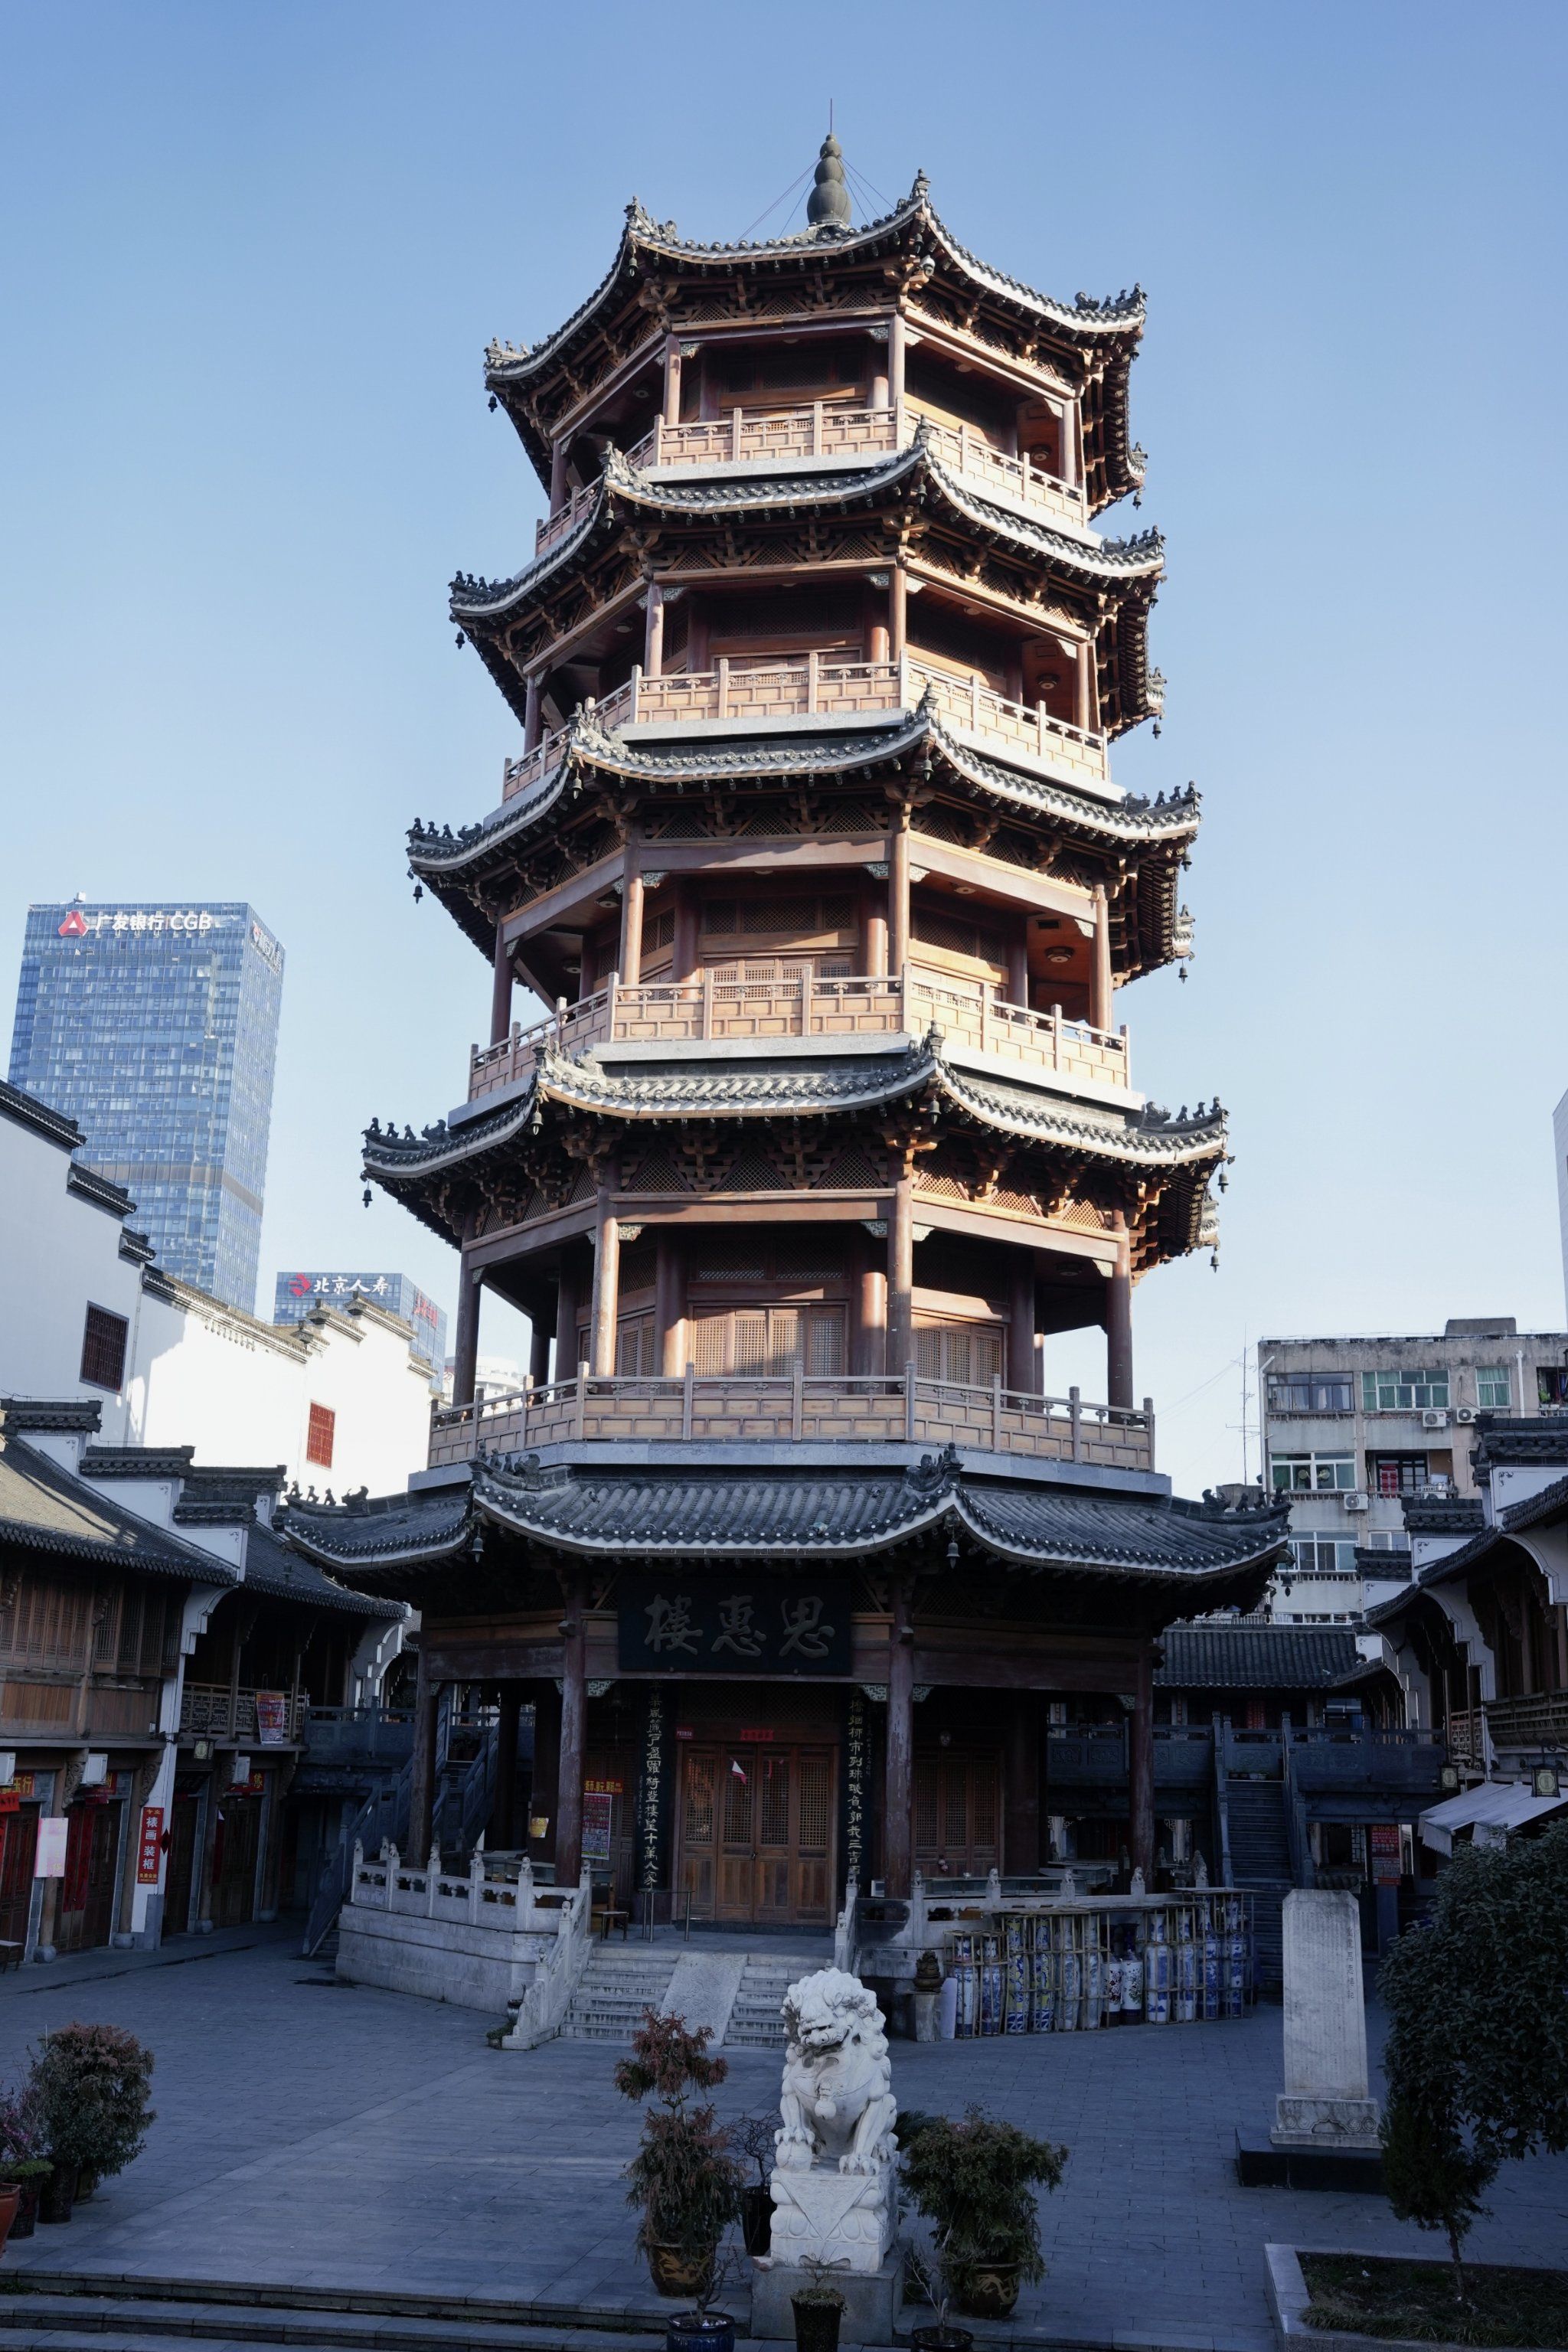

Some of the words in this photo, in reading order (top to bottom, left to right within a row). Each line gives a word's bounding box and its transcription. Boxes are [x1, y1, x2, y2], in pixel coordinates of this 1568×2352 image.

[94, 914, 165, 932] 广发银行
[170, 914, 213, 931] CGB
[313, 1276, 388, 1295] 北京人寿
[142, 1816, 158, 1870] 裱画装框
